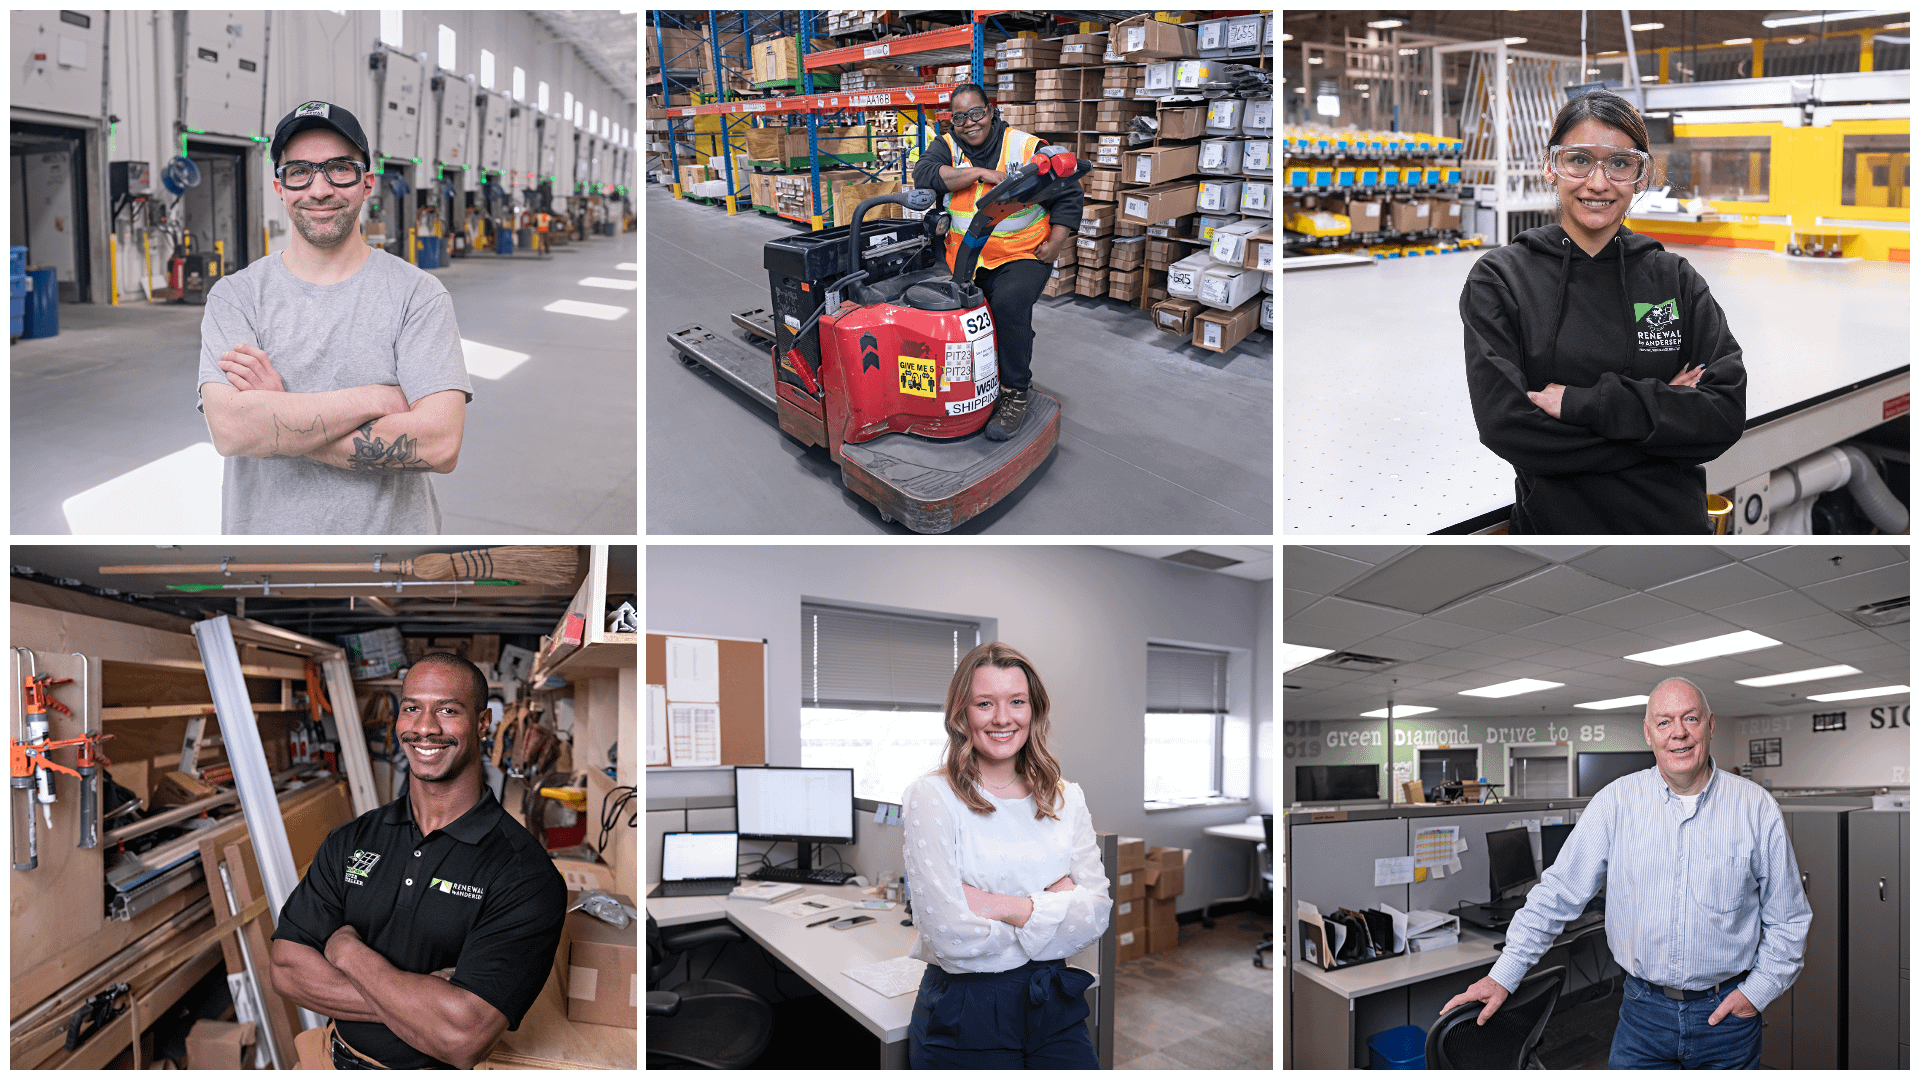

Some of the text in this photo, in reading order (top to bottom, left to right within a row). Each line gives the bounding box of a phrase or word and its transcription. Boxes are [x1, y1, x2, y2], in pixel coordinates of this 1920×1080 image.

[967, 312, 991, 334] S23
[1638, 330, 1681, 339] RENEWAL
[945, 350, 972, 361] PIT23
[900, 361, 915, 371] GIVE
[916, 363, 928, 373] ME
[945, 366, 972, 377] PIT23
[1739, 716, 1793, 735] TRUST
[1326, 721, 1605, 747] Green Diamond Drive to 85
[452, 882, 484, 895] RENEWAL
